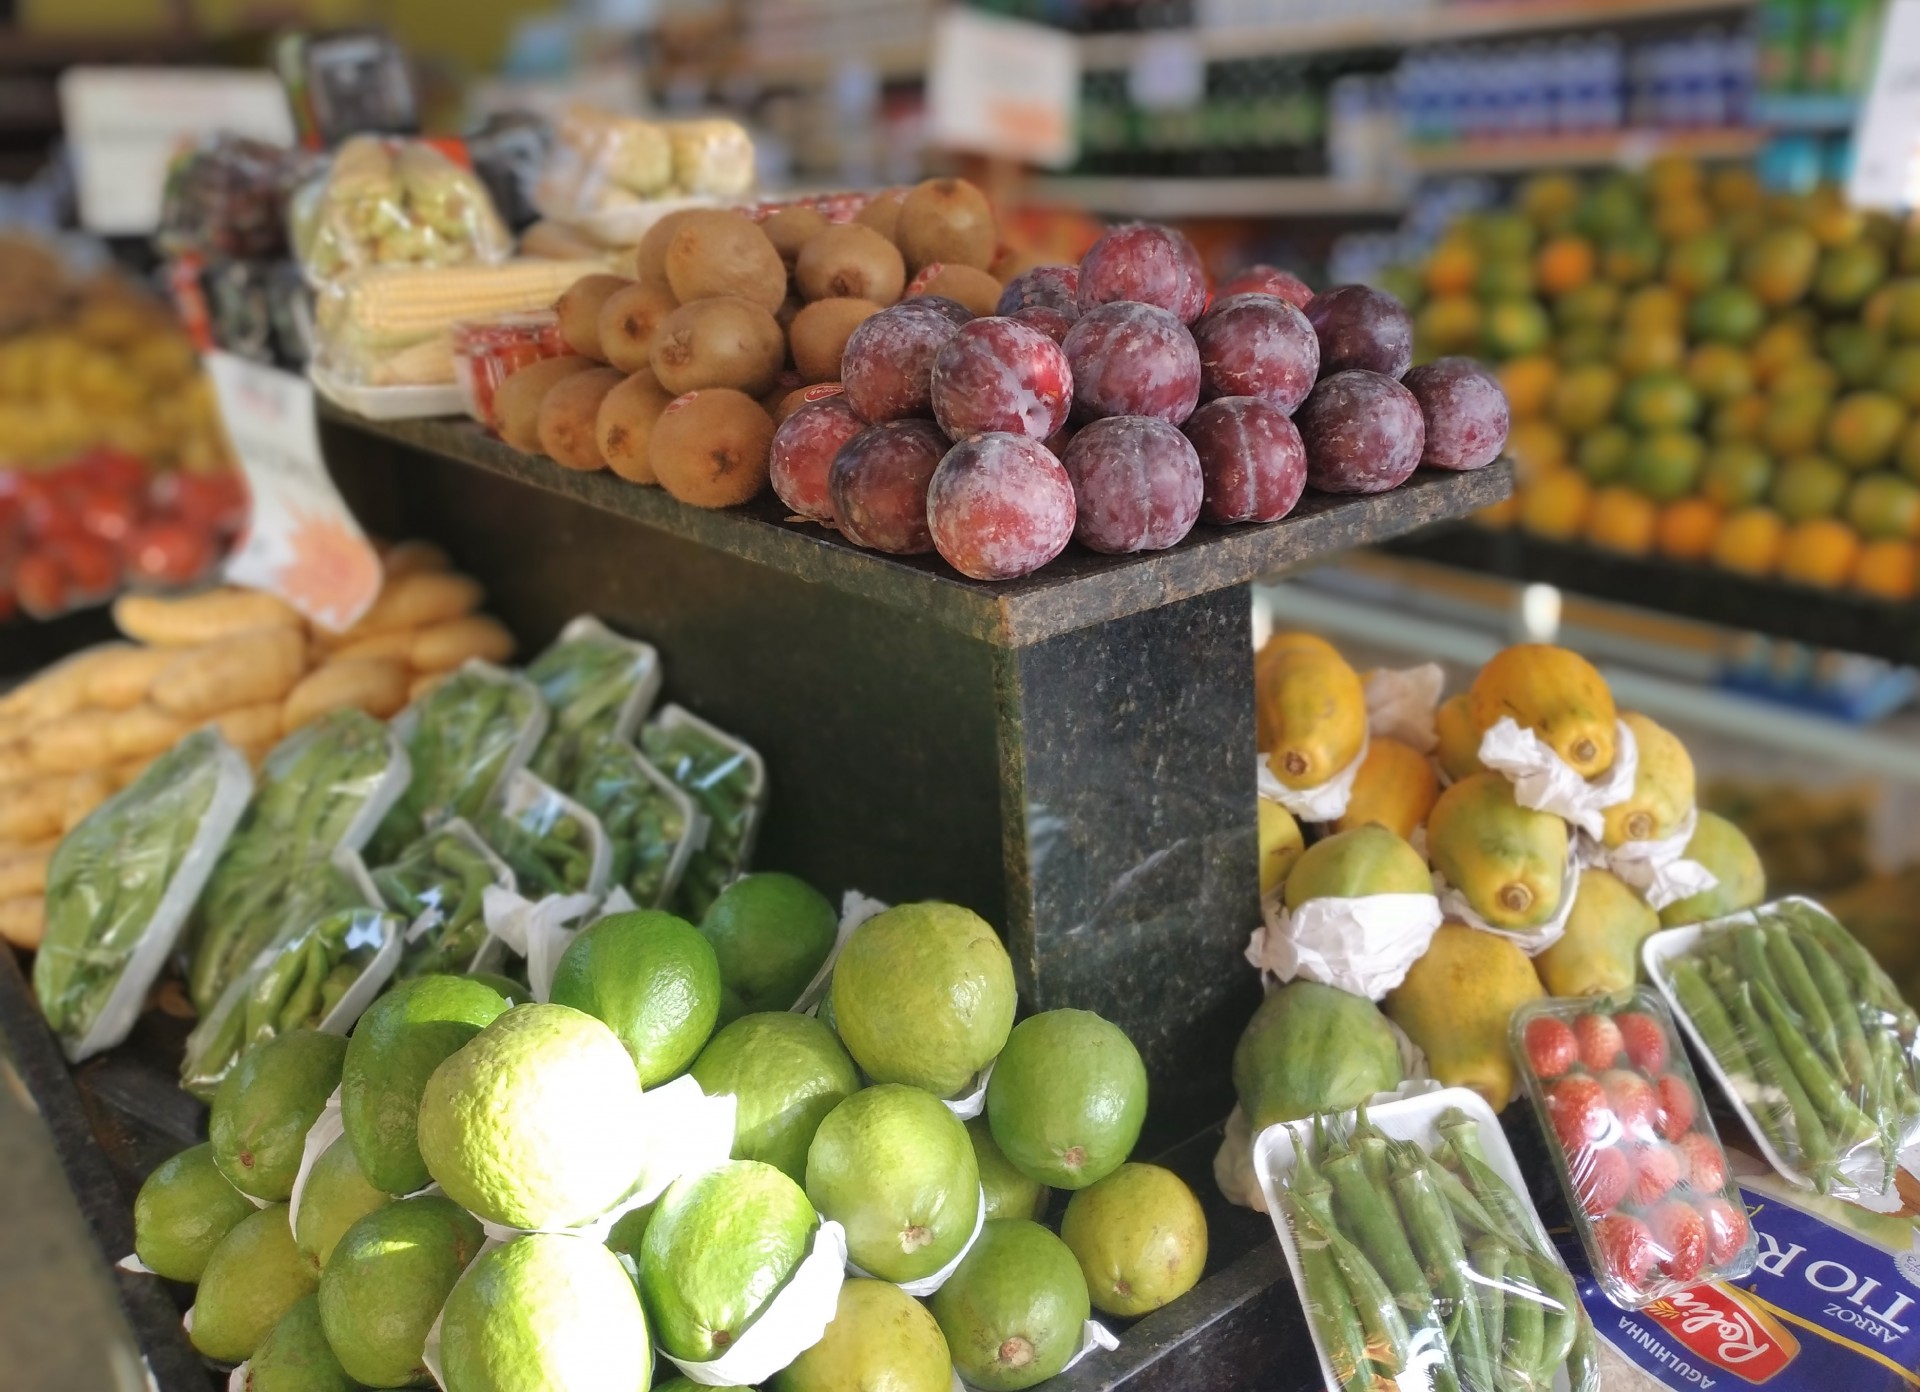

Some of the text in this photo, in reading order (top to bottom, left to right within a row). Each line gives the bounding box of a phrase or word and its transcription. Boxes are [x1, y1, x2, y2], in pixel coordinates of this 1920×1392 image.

[1758, 1232, 1915, 1333] TIO R
[1618, 1316, 1716, 1389] AGULHINHA
[1823, 1303, 1901, 1343] ARROZ
